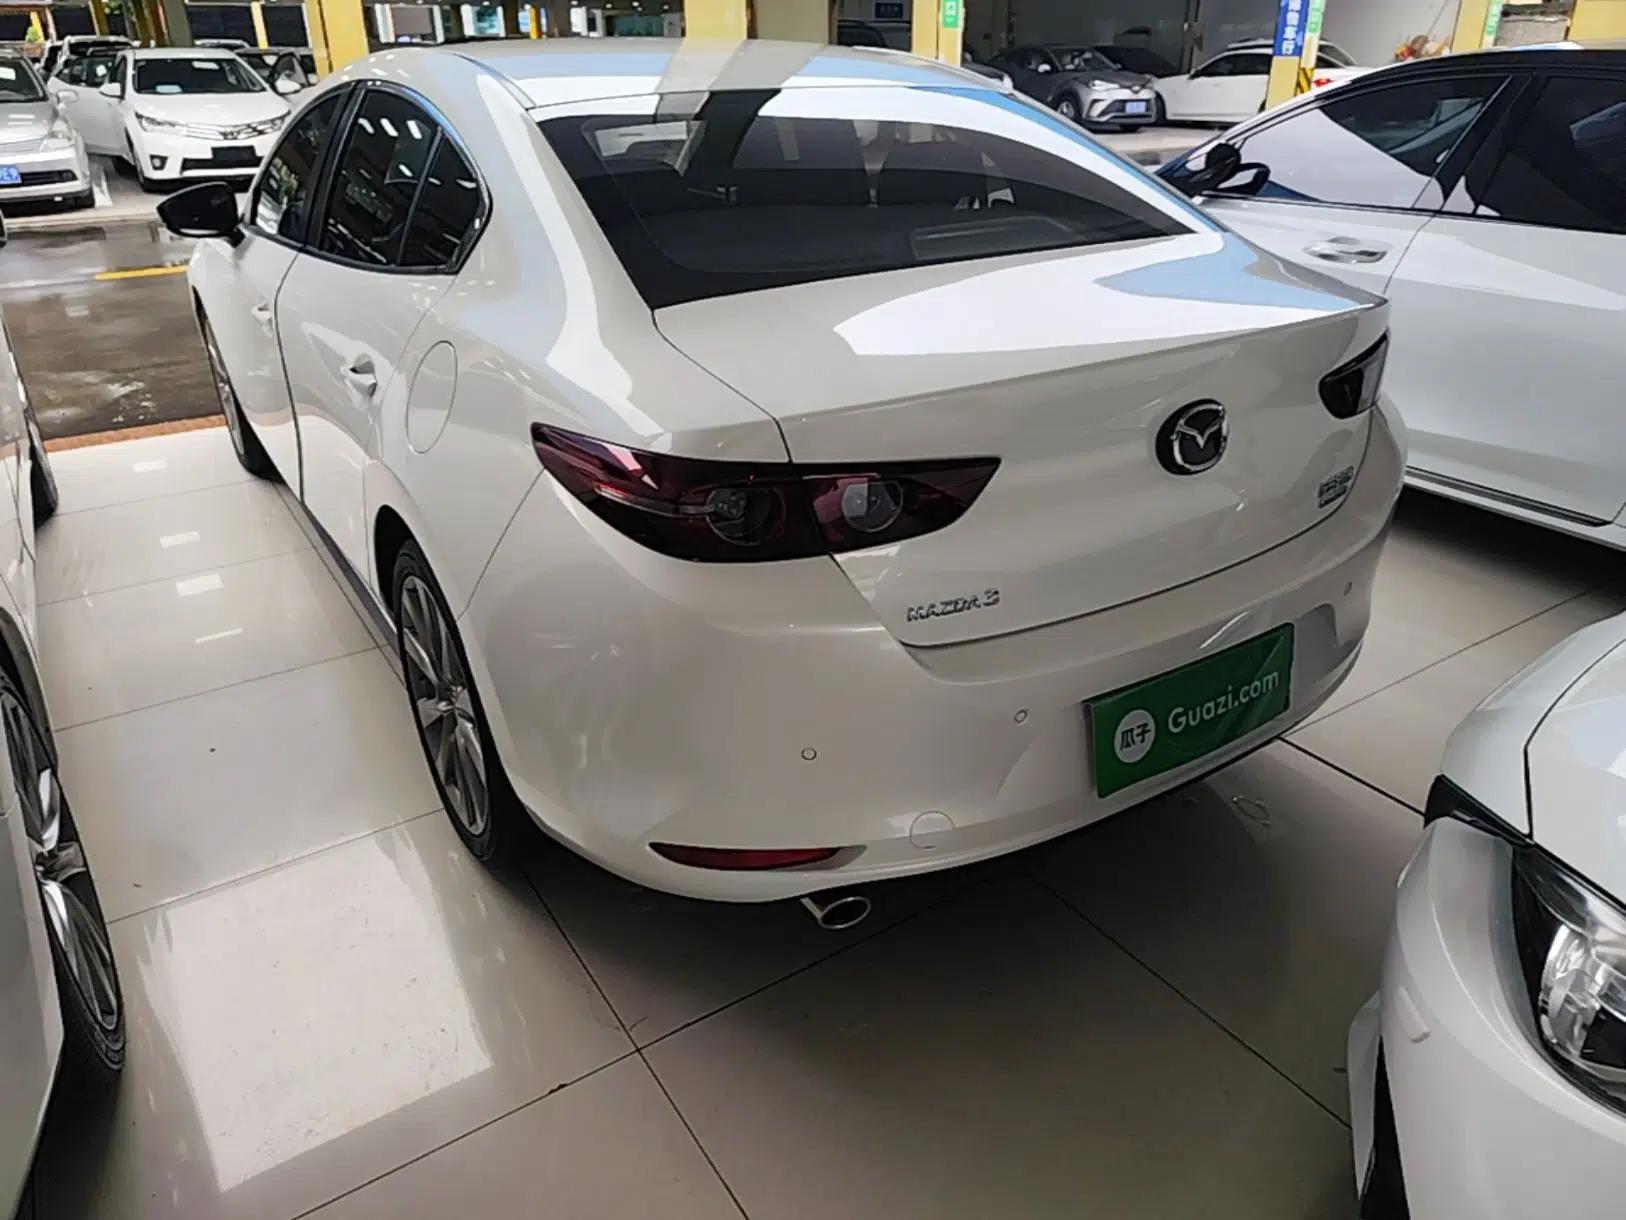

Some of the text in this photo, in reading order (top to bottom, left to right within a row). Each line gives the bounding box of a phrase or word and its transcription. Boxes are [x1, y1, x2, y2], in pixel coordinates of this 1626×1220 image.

[906, 588, 1000, 622] MAZDA 3
[1168, 671, 1279, 733] Guazi.com
[1120, 722, 1151, 751] 瓜子
